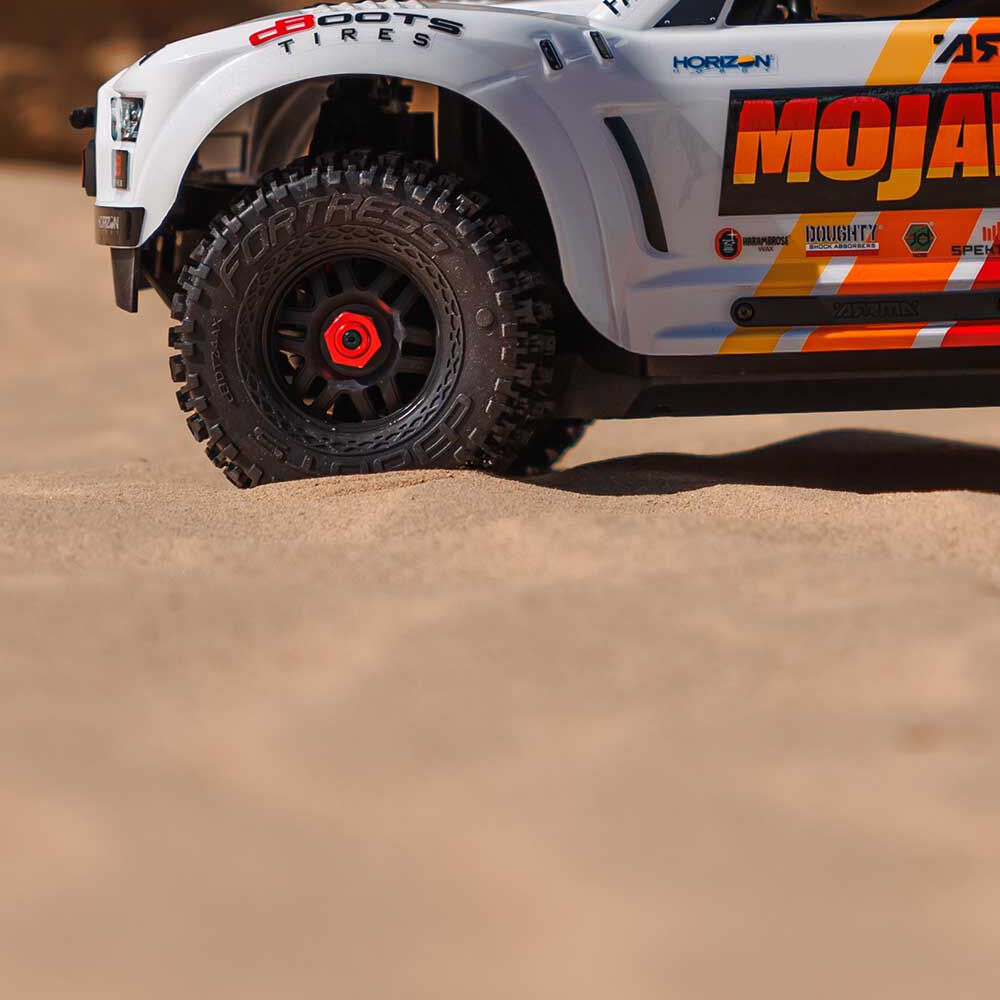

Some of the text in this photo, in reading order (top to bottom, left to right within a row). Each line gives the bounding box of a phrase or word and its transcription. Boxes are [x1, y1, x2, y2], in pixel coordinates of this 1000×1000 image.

[278, 27, 431, 55] TIRES
[672, 54, 772, 69] HORIZON
[806, 224, 878, 243] DOUGHTY
